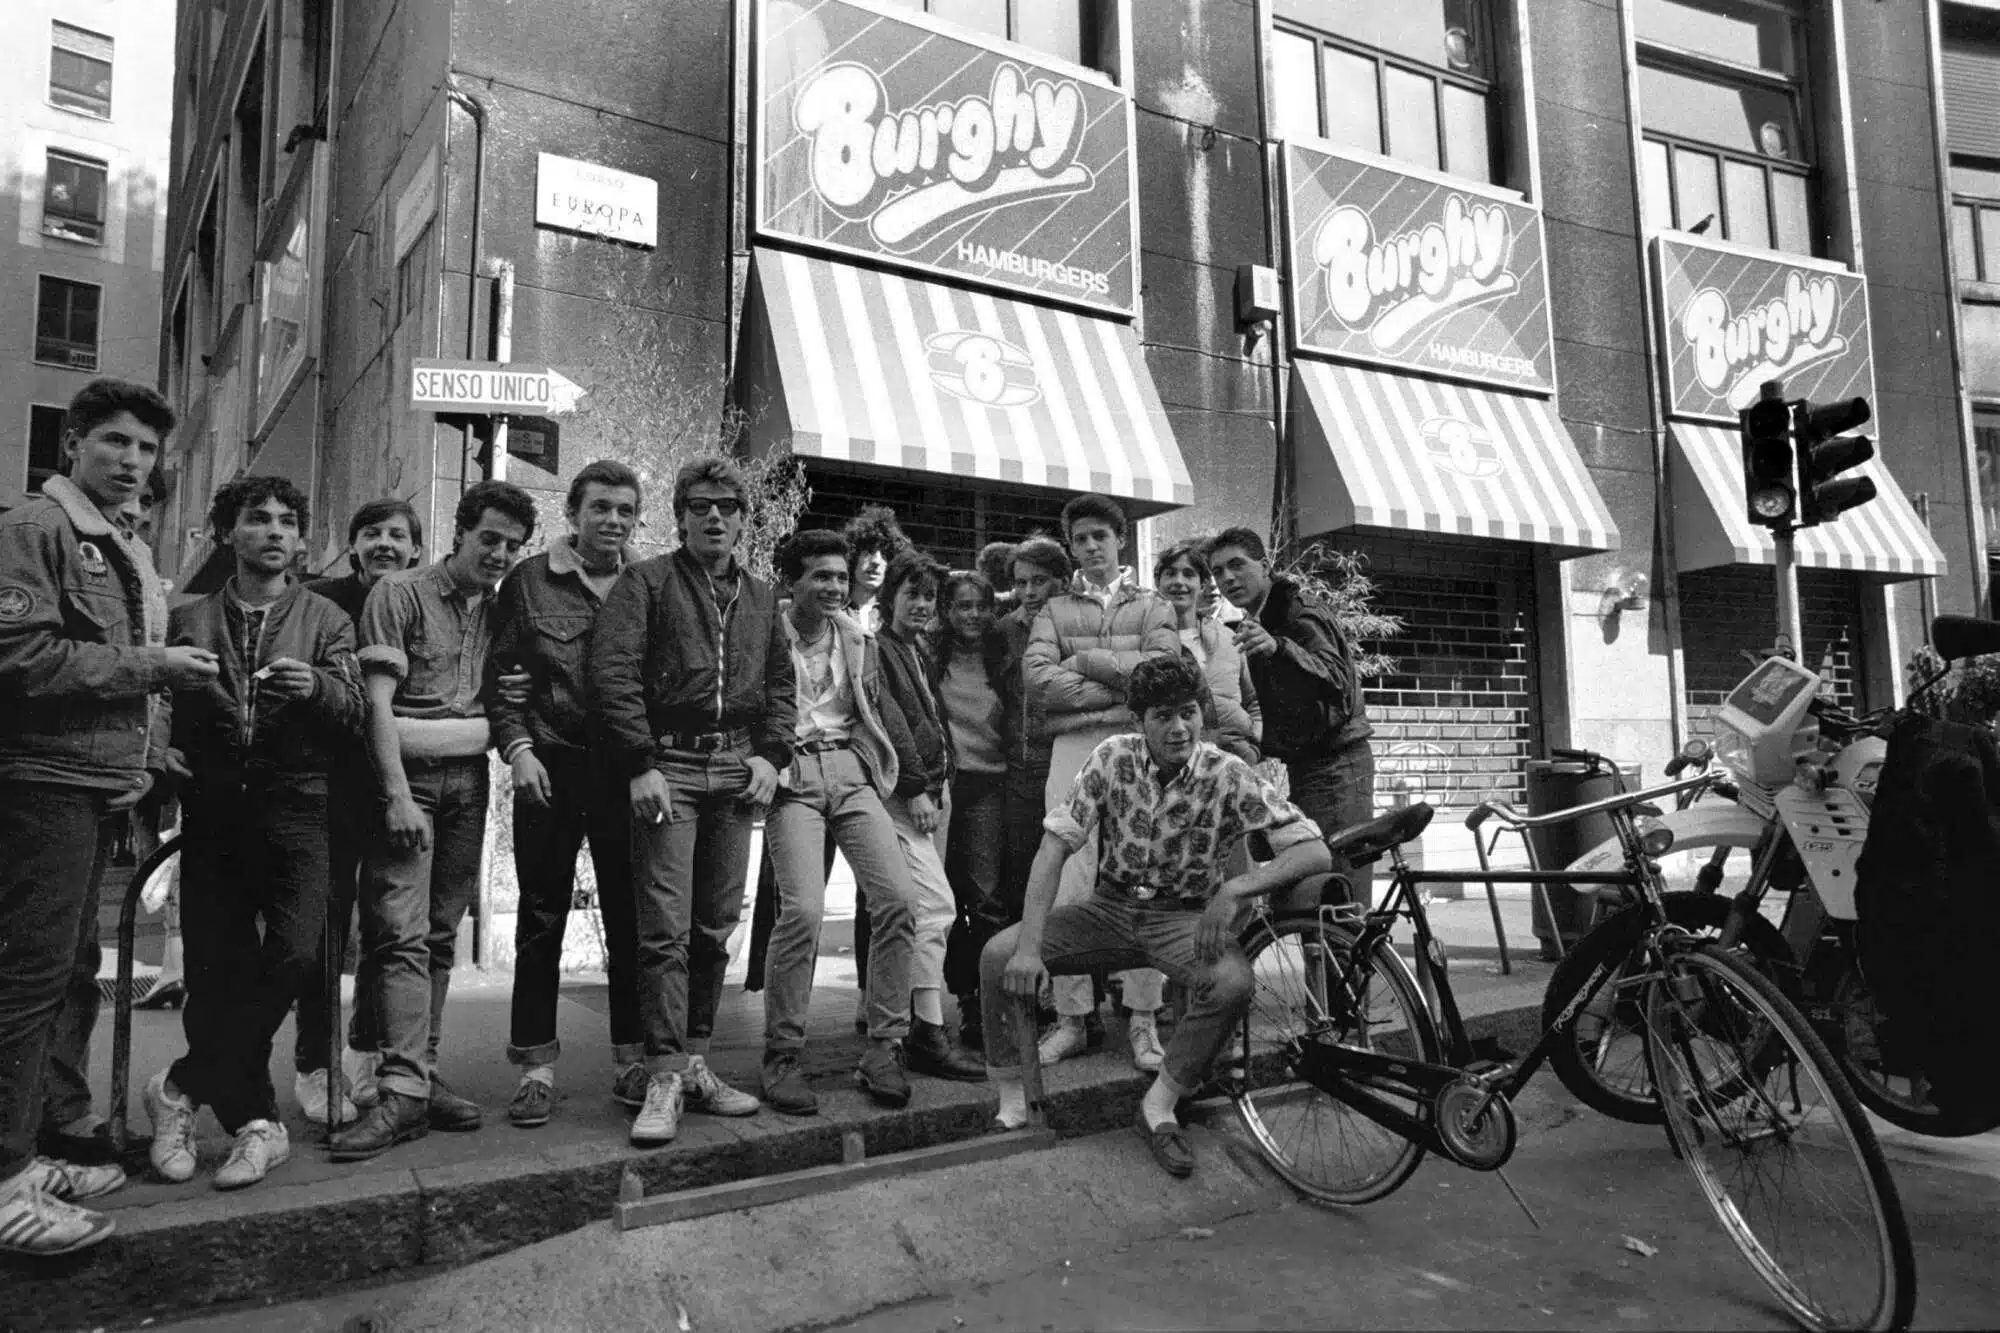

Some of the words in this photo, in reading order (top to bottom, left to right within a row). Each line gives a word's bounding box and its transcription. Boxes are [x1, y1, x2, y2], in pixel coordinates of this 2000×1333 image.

[793, 62, 1085, 213] Burghy
[551, 192, 645, 227] EUROPA
[957, 241, 1110, 295] HAMBURGERS
[1314, 194, 1508, 326] Burghy
[1684, 271, 1840, 393] Burghy
[414, 371, 483, 401] SENSO
[490, 375, 550, 402] UNICO
[1428, 342, 1537, 378] HAMBURGERS
